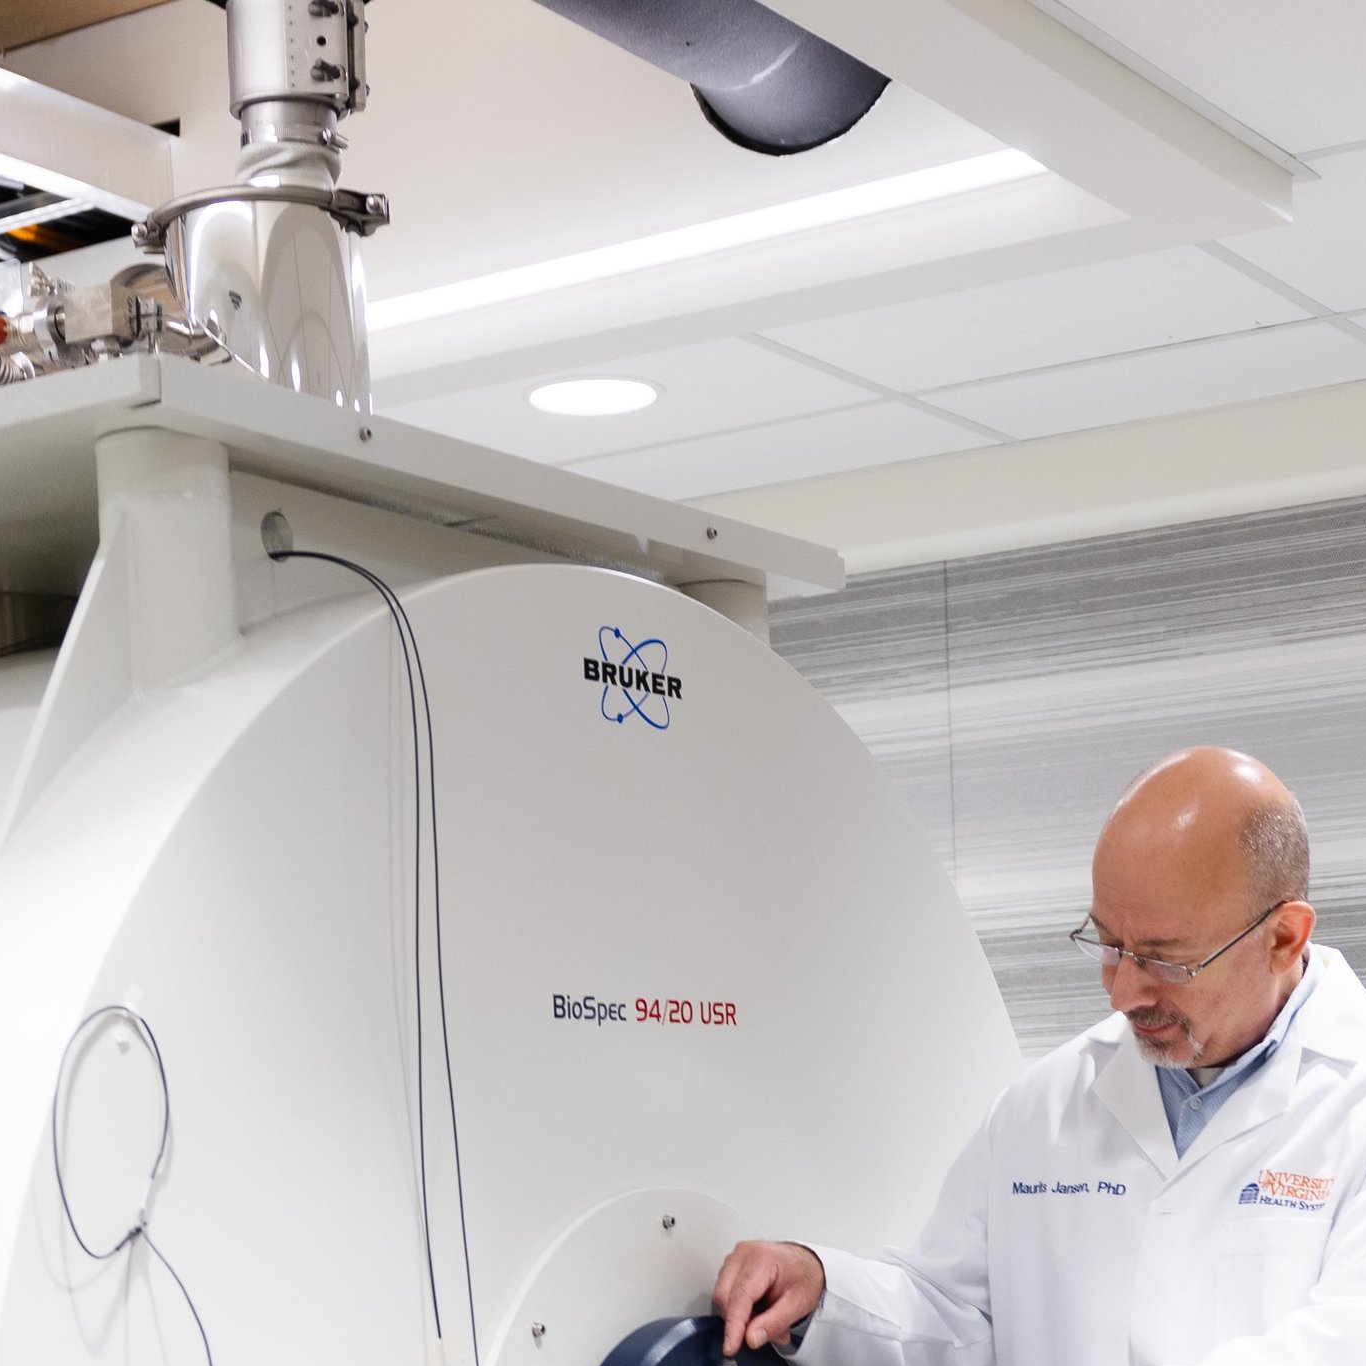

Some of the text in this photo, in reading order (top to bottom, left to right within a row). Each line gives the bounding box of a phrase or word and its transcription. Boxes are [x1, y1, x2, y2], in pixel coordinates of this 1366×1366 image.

[583, 657, 683, 700] BRUKER
[553, 994, 738, 1026] BioSpec 94/20 USR
[1097, 1181, 1126, 1195] PhD
